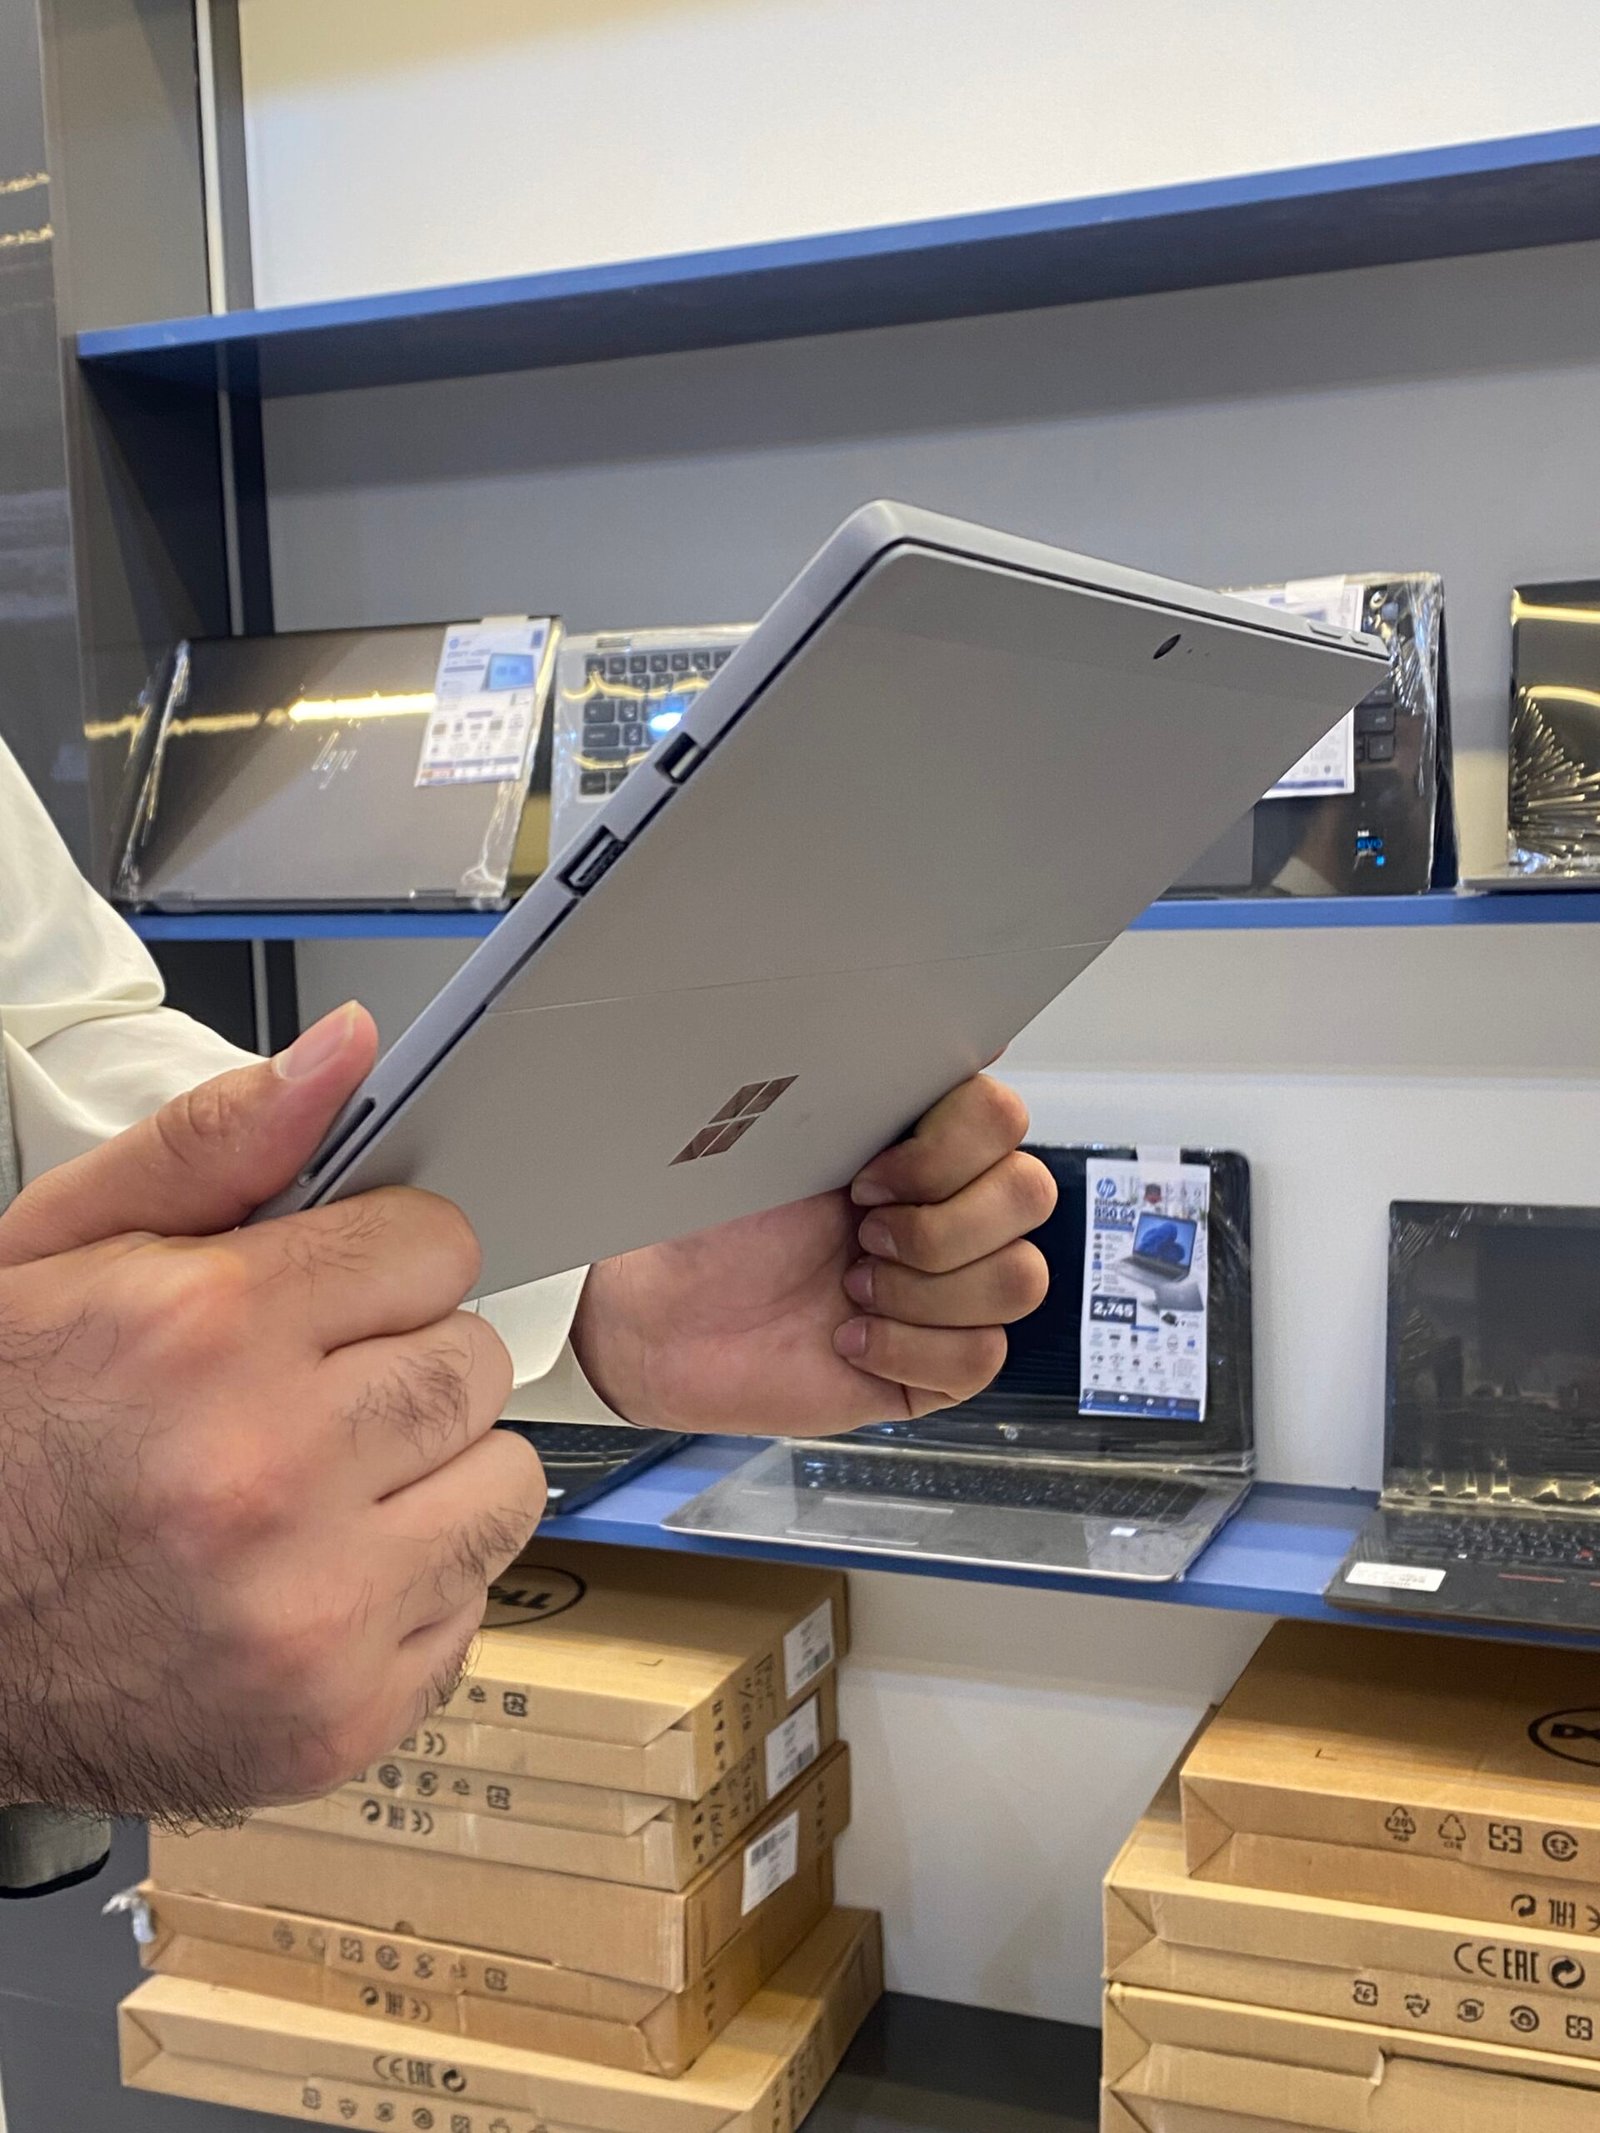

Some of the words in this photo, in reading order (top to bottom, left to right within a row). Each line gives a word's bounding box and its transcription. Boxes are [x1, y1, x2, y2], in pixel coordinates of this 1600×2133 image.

[1096, 1177, 1116, 1199] hp
[1454, 1942, 1497, 1978] CE
[1503, 1948, 1540, 1984] EAC
[373, 2055, 405, 2083] CE
